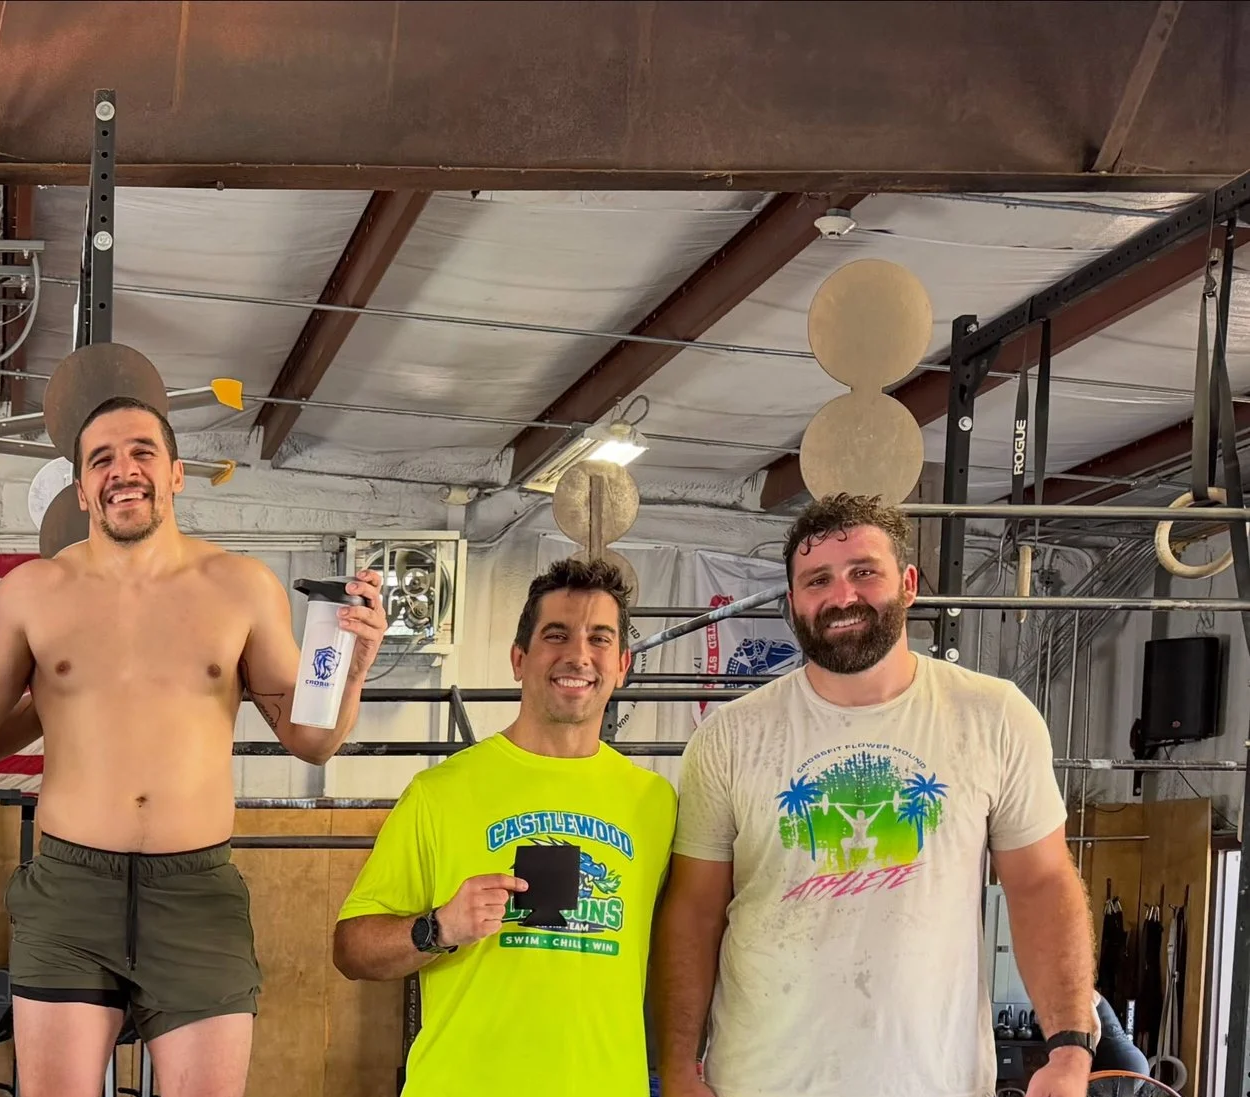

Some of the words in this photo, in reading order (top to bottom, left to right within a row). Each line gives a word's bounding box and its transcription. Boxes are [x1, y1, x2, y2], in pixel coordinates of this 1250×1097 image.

[1013, 419, 1027, 476] ROGUE
[796, 746, 842, 774] CROSSFIT
[845, 742, 890, 750] FLOWER
[892, 746, 927, 770] MOUND
[486, 810, 635, 860] CASTLEWOOD
[780, 862, 927, 902] ATHLETE
[505, 935, 540, 946] SWIM
[552, 938, 582, 949] CHILL
[592, 942, 613, 952] WIN
